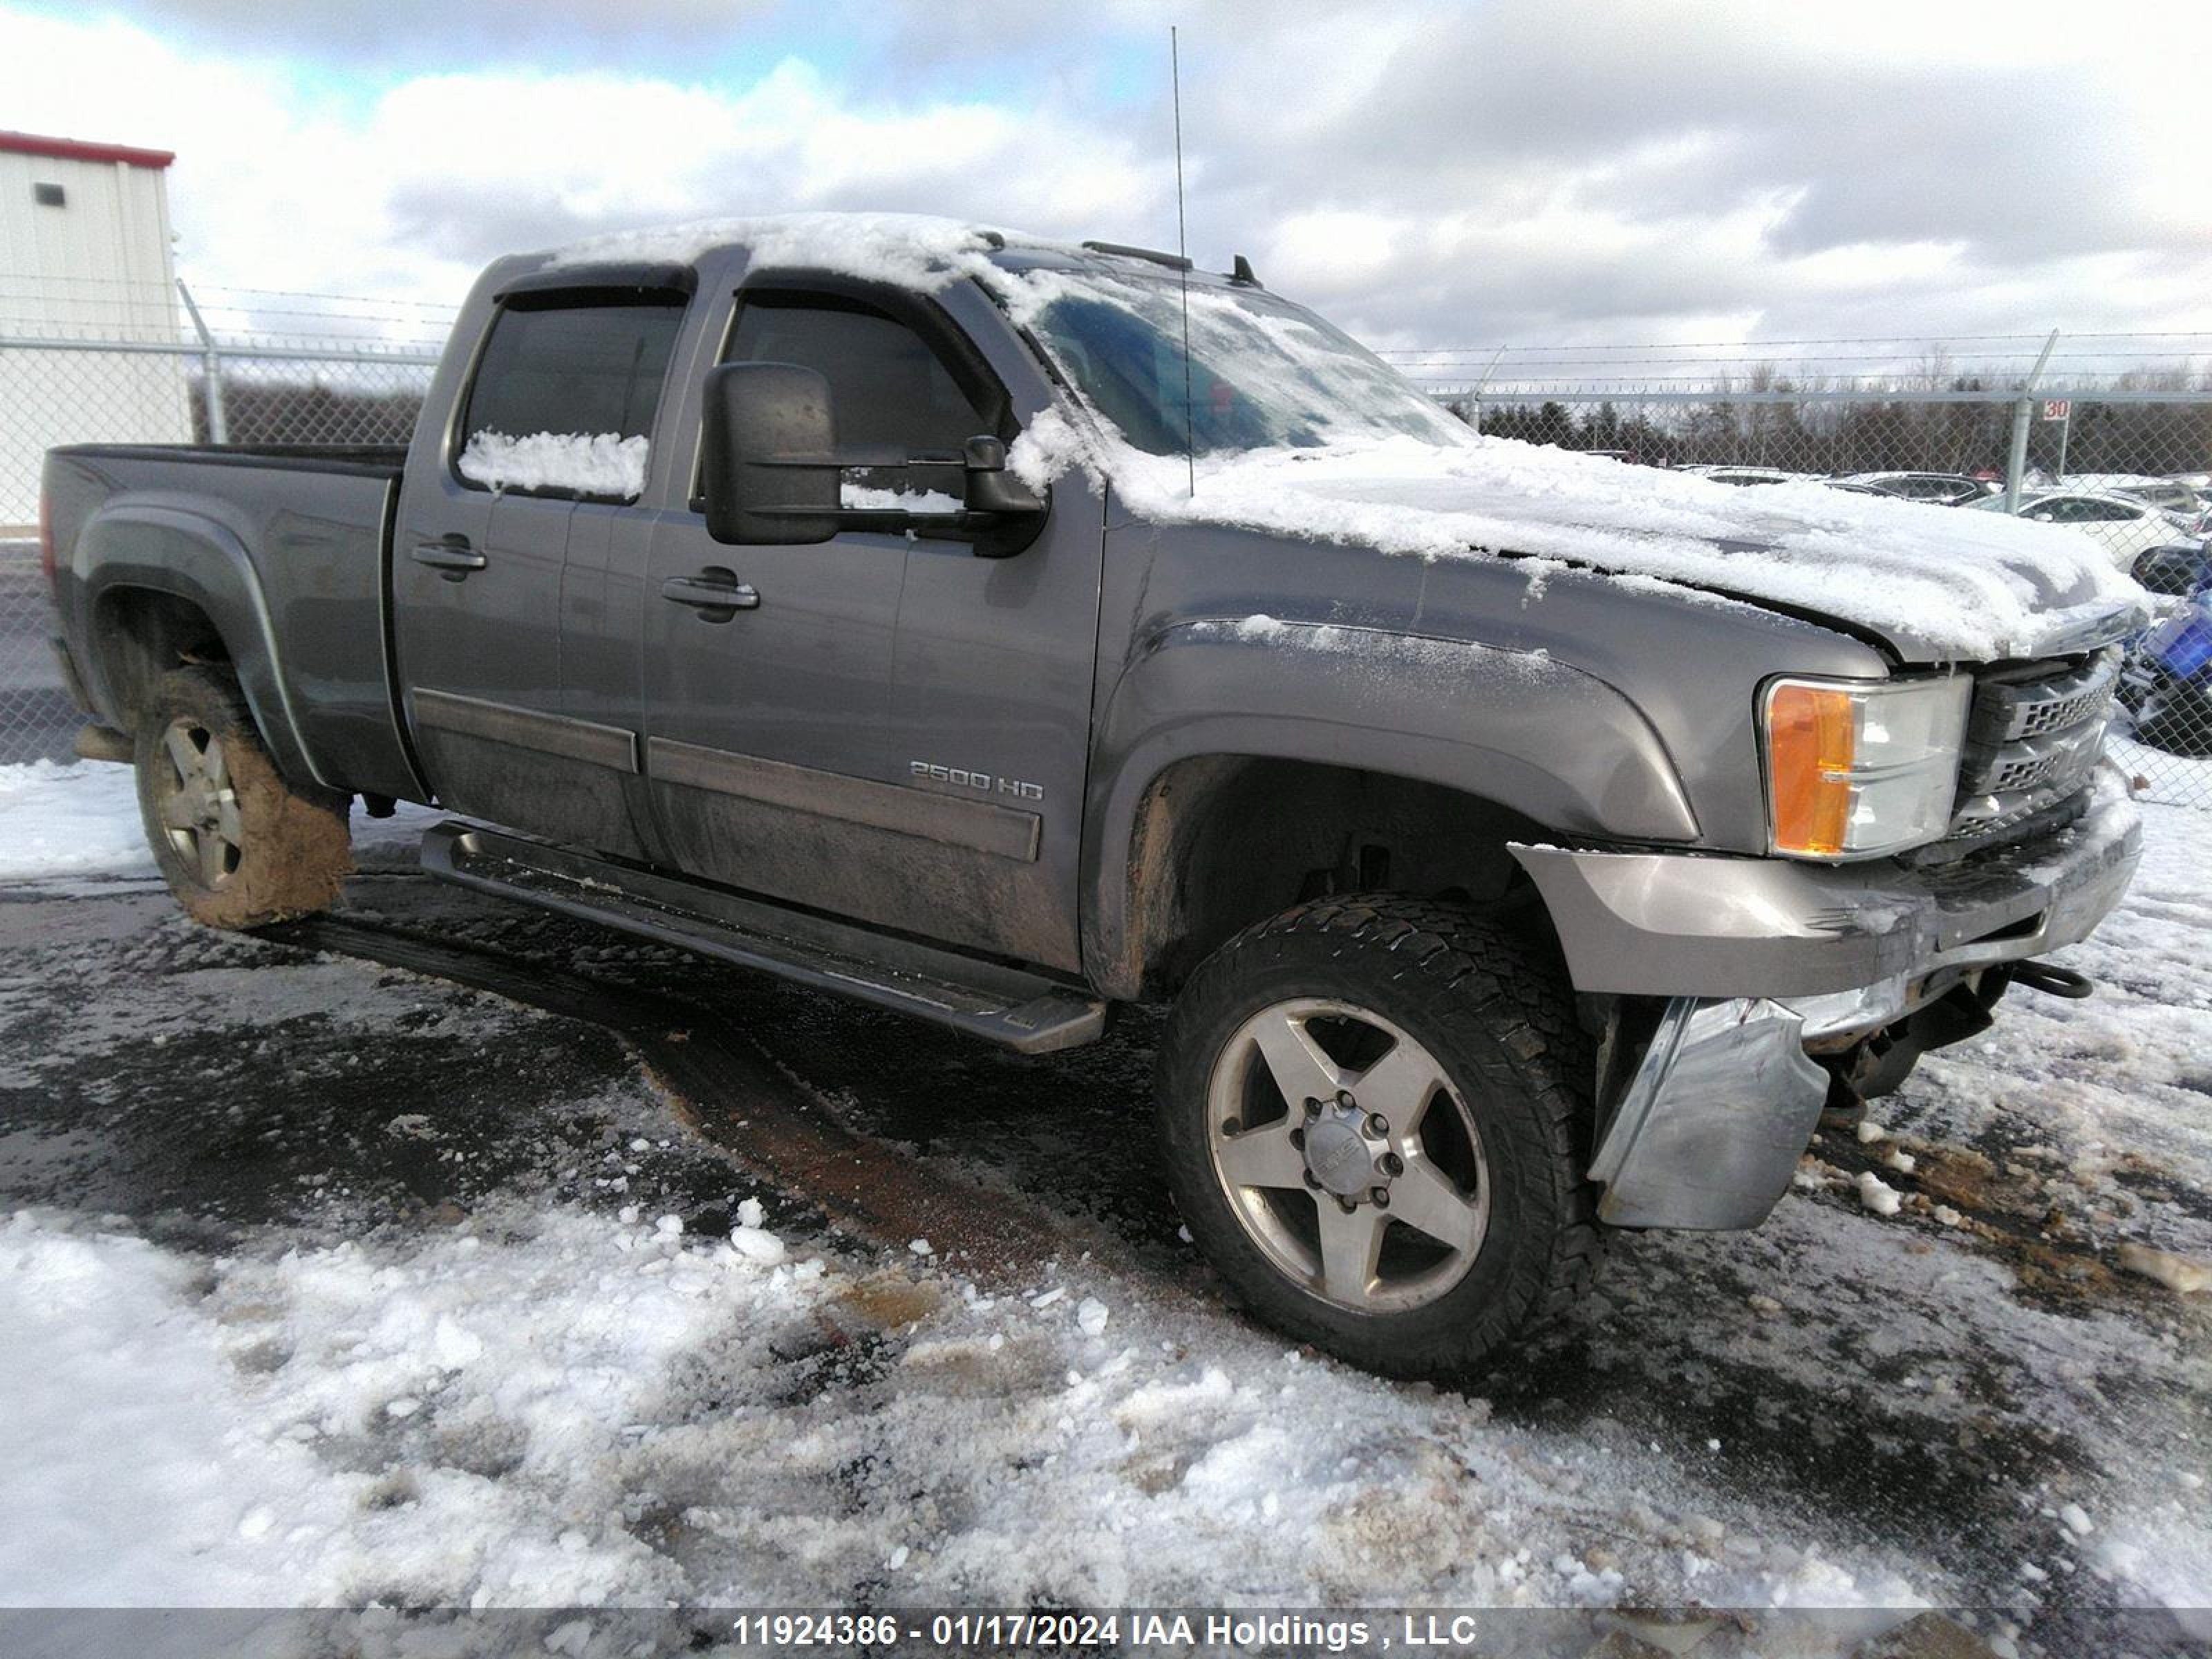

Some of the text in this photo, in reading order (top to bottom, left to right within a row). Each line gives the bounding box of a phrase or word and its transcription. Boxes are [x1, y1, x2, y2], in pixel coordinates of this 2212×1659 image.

[2045, 401, 2068, 417] 30
[910, 761, 1043, 799] 2500 HD
